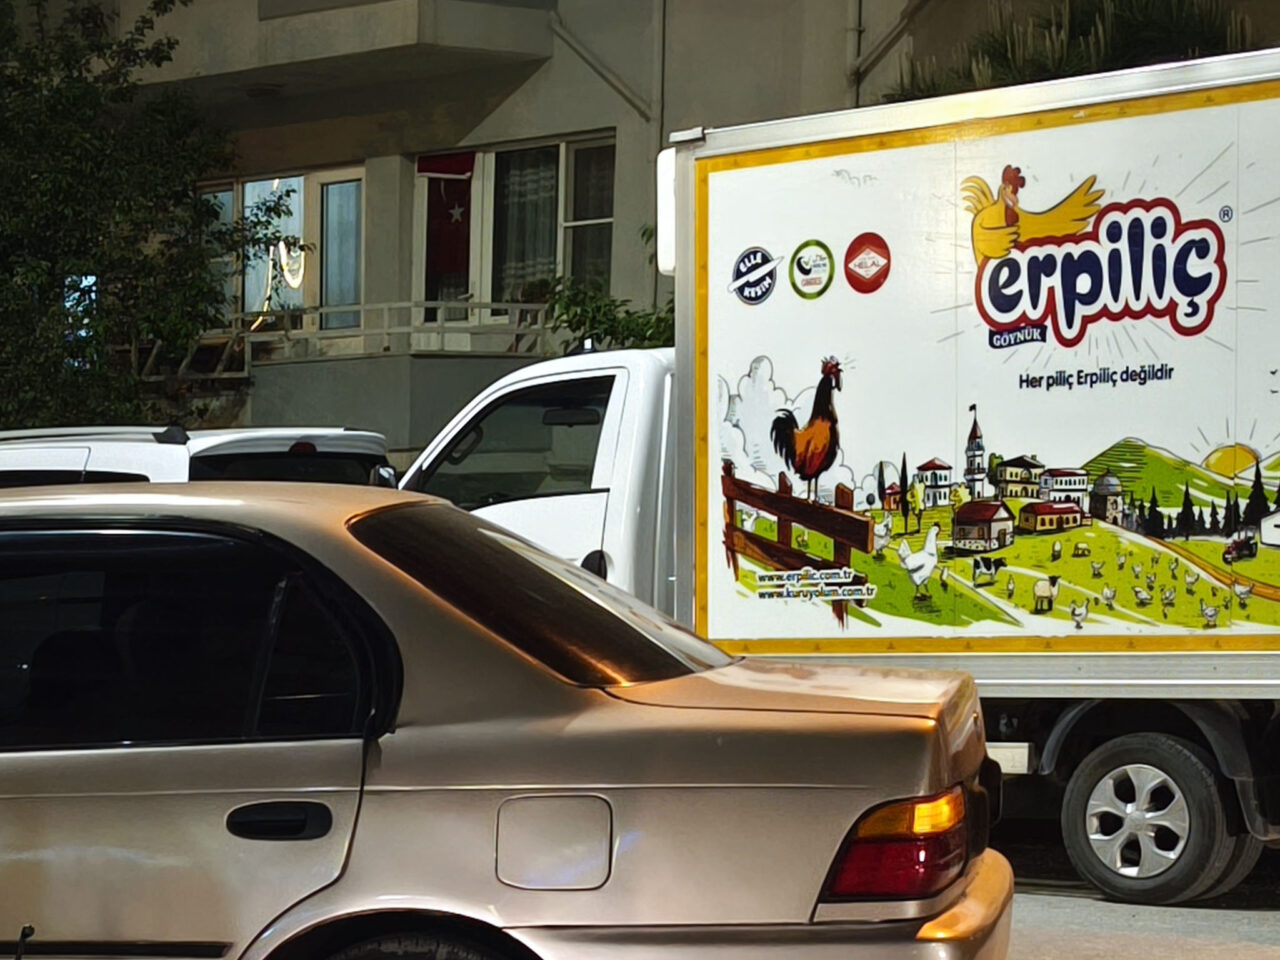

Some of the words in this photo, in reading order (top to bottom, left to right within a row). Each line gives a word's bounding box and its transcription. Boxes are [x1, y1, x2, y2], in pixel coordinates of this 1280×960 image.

[738, 252, 762, 273] ELLE
[988, 216, 1212, 330] erpiliç
[993, 327, 1041, 347] GÖYNÜK
[1019, 374, 1043, 389] Her
[1046, 370, 1074, 391] piliç
[1077, 368, 1118, 388] Erpiliç
[1120, 364, 1174, 386] değildir
[758, 570, 852, 583] www.erpilic.com.tr
